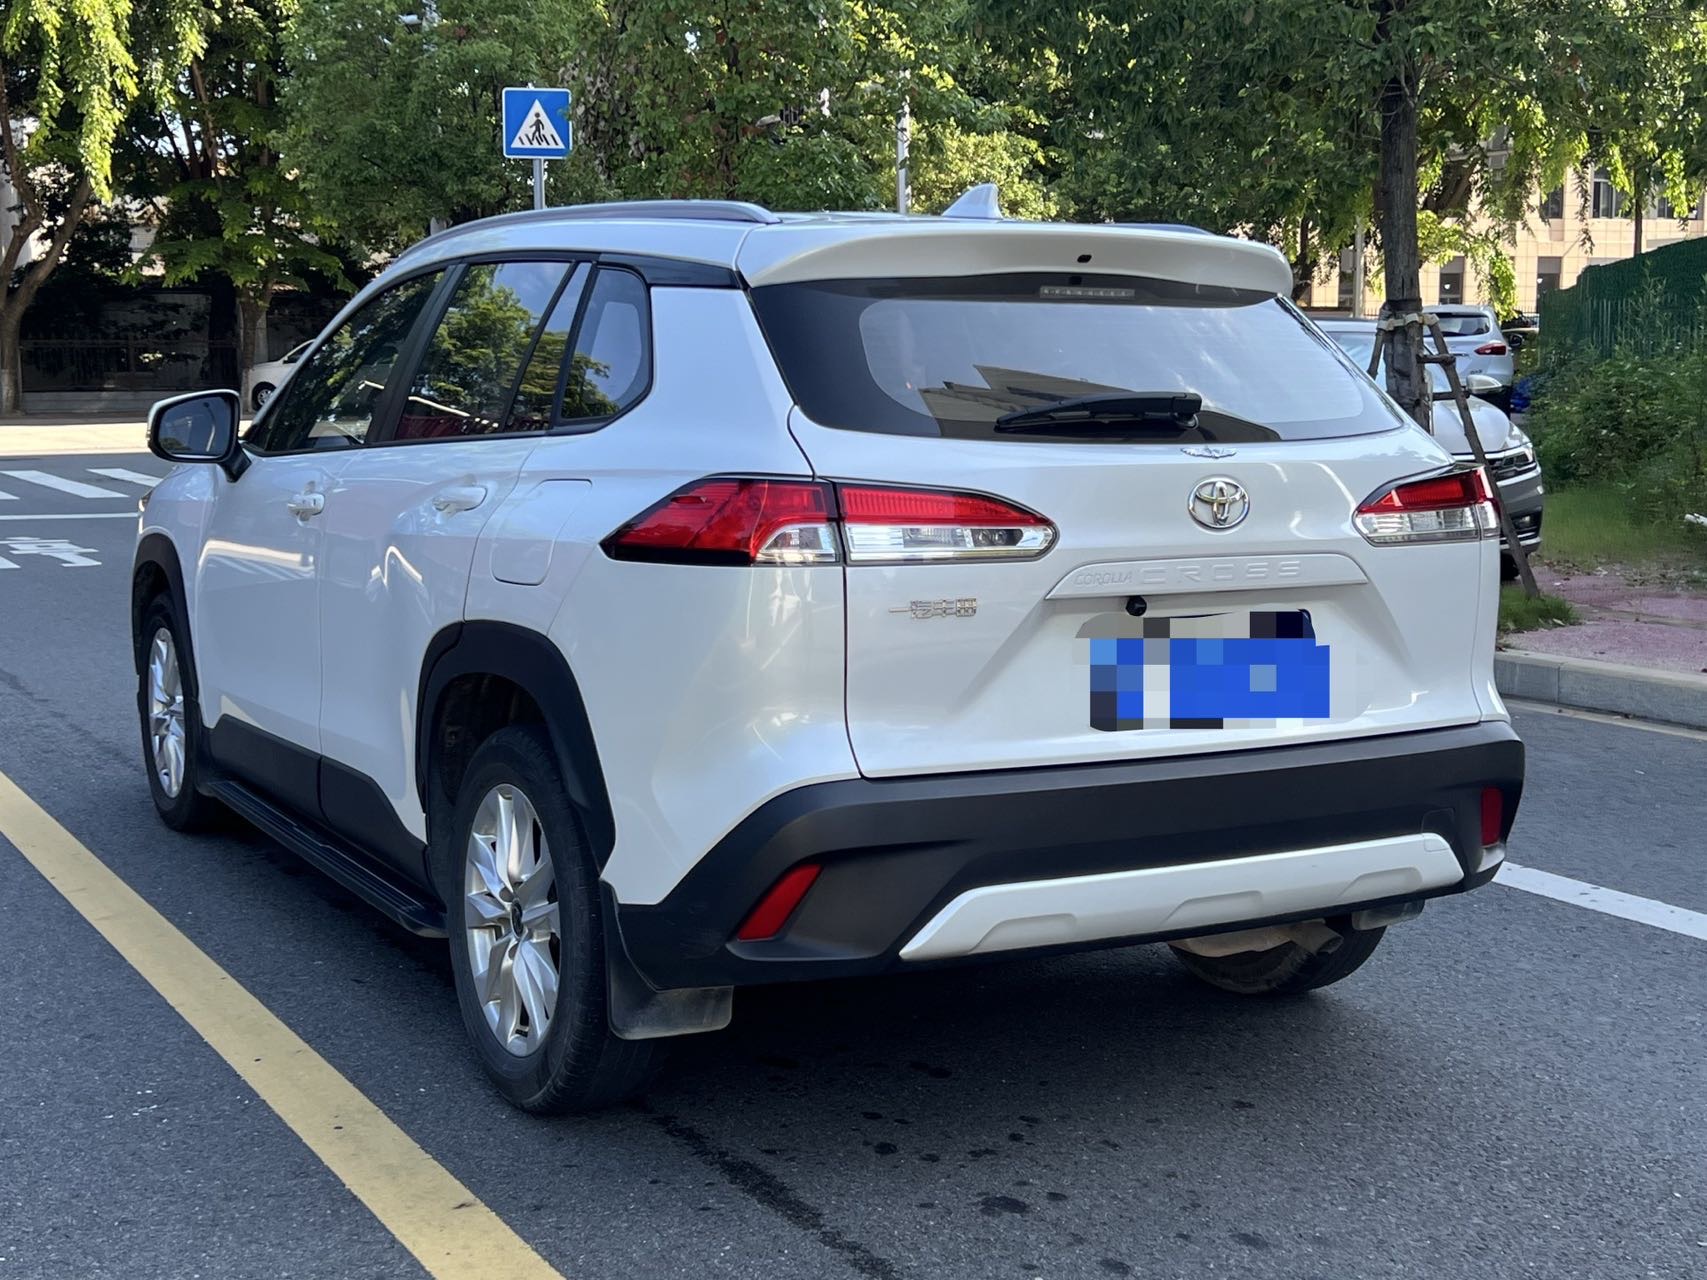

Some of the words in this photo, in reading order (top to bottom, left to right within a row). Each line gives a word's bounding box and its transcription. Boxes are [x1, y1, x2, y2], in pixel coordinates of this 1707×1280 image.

[1073, 571, 1133, 586] COROLLA
[1140, 560, 1302, 585] CROSS
[888, 598, 977, 619] 一汽丰田
